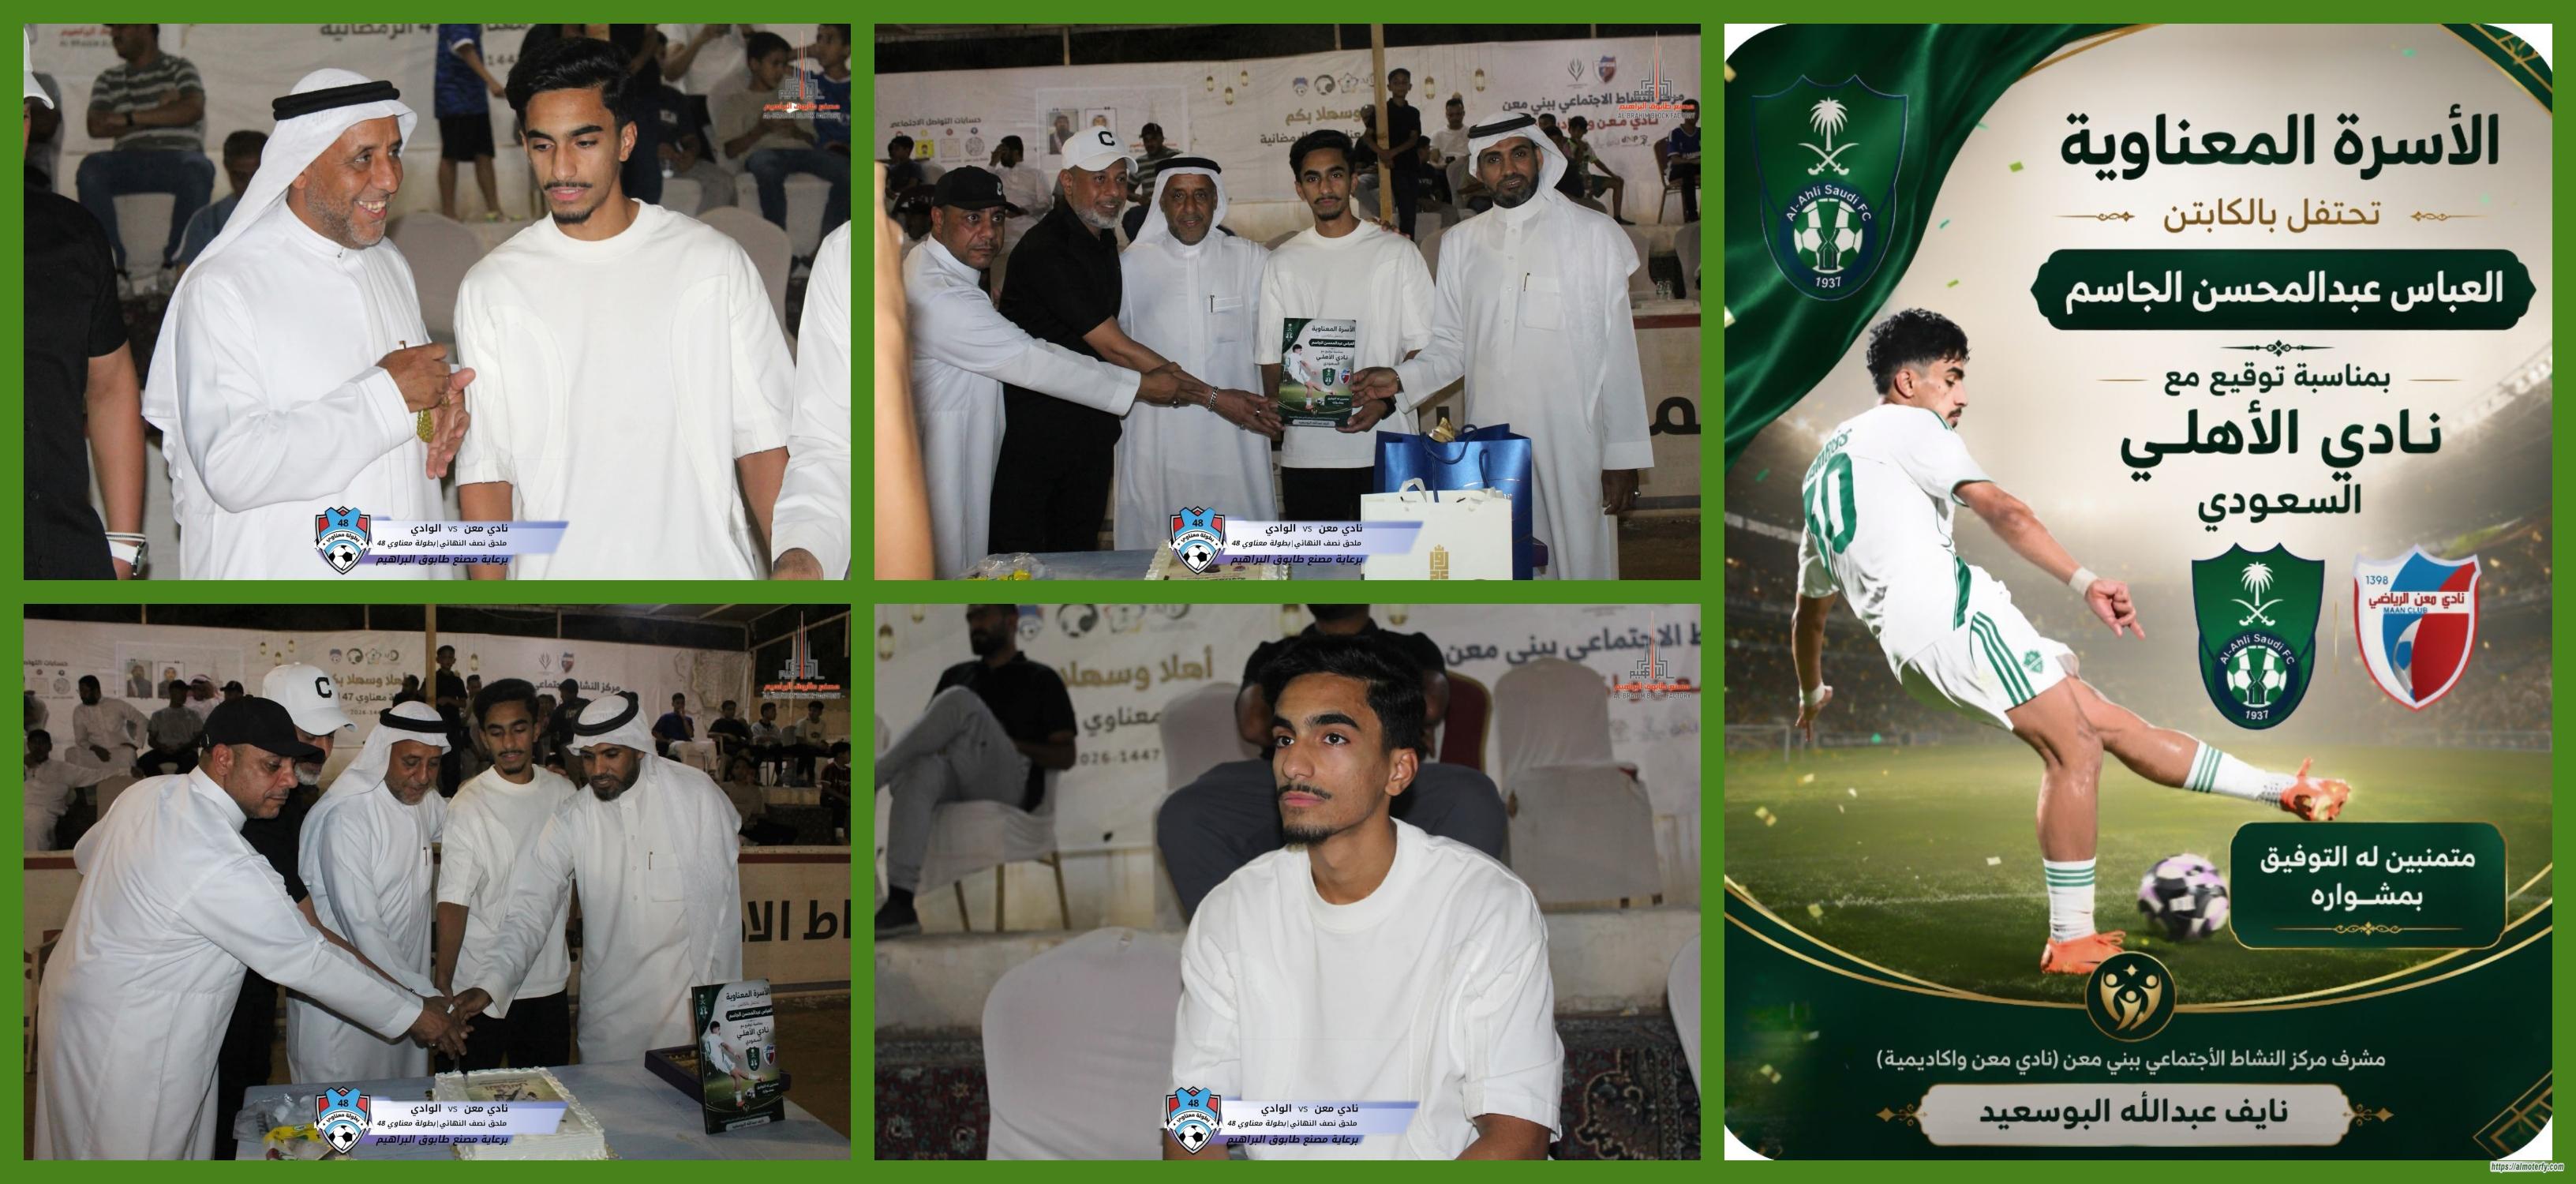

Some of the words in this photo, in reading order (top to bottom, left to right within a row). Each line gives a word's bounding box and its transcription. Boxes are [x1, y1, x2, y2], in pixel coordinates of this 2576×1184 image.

[1502, 100, 1528, 111] معن
[1559, 93, 1612, 114] الاجتماعي
[1286, 108, 1312, 126] بكم
[1098, 131, 1115, 146] C
[2061, 113, 2316, 182] المعناوية
[2334, 103, 2499, 182] الأسرة
[1786, 185, 1822, 222] Al-Ahli
[1825, 184, 1858, 205] Saudi
[1857, 203, 1872, 222] FC
[2163, 197, 2278, 234] بالكابتن
[2287, 198, 2382, 234] تحتفل
[1816, 276, 1841, 288] 1937
[2065, 270, 2183, 315] الجاسم
[2192, 270, 2381, 313] عبدالمحسن
[2391, 270, 2503, 313] العباس
[2164, 371, 2200, 396] مع
[2209, 362, 2286, 396] توقيع
[2293, 362, 2391, 394] بمناسبة
[2121, 399, 2298, 482] الأهلي
[2321, 408, 2443, 482] نادي
[2198, 483, 2361, 533] السعودي
[2365, 575, 2388, 585] 1398
[2368, 592, 2409, 609] الرياضي
[2413, 592, 2437, 606] معن
[2441, 592, 2465, 609] نادي
[1446, 643, 1498, 665] معن
[2220, 635, 2250, 665] Al-Ahli
[2253, 634, 2284, 653] Saudi
[2281, 650, 2296, 665] FC
[1160, 644, 1212, 682] أهلا
[315, 676, 332, 699] C
[578, 681, 600, 691] النشا
[601, 684, 620, 693] مركز
[2245, 710, 2270, 721] 1937
[2260, 844, 2348, 874] التوفيق
[2355, 845, 2379, 867] له
[2385, 848, 2477, 874] متمنبين
[1876, 1049, 1968, 1071] واكاديمية)
[1971, 1054, 2011, 1071] معن
[2015, 1049, 2059, 1076] (نادي
[2062, 1054, 2102, 1071] معن
[2106, 1052, 2141, 1076] ببني
[2145, 1047, 2226, 1075] الأجتماعي
[2230, 1049, 2286, 1067] النشاط
[2288, 1050, 2327, 1071] مركز
[2331, 1049, 2387, 1072] مشرف
[1979, 1098, 2111, 1130] البوسعيد
[2224, 1098, 2289, 1130] نايف
